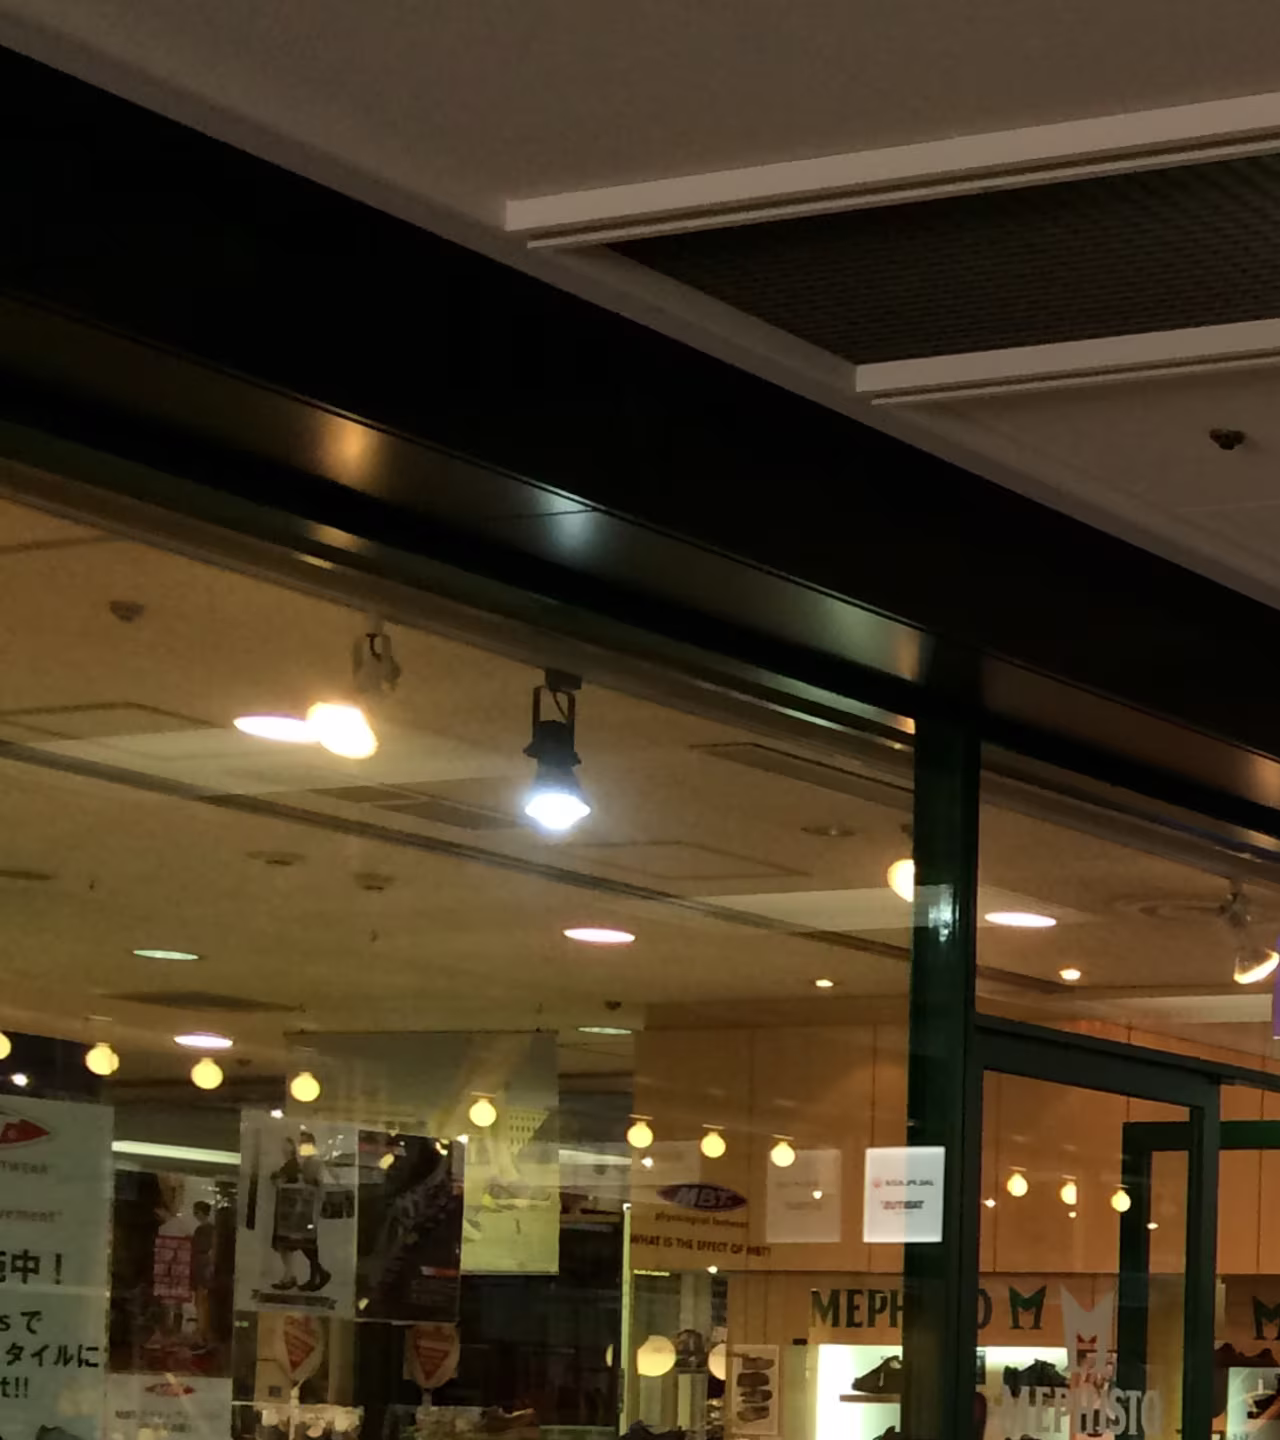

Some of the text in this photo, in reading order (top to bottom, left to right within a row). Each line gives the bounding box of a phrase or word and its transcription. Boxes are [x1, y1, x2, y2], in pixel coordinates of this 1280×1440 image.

[630, 1233, 661, 1248] WHAT
[663, 1236, 673, 1249] IS
[675, 1238, 694, 1251] THE
[1002, 1384, 1166, 1436] MEPHISTO
